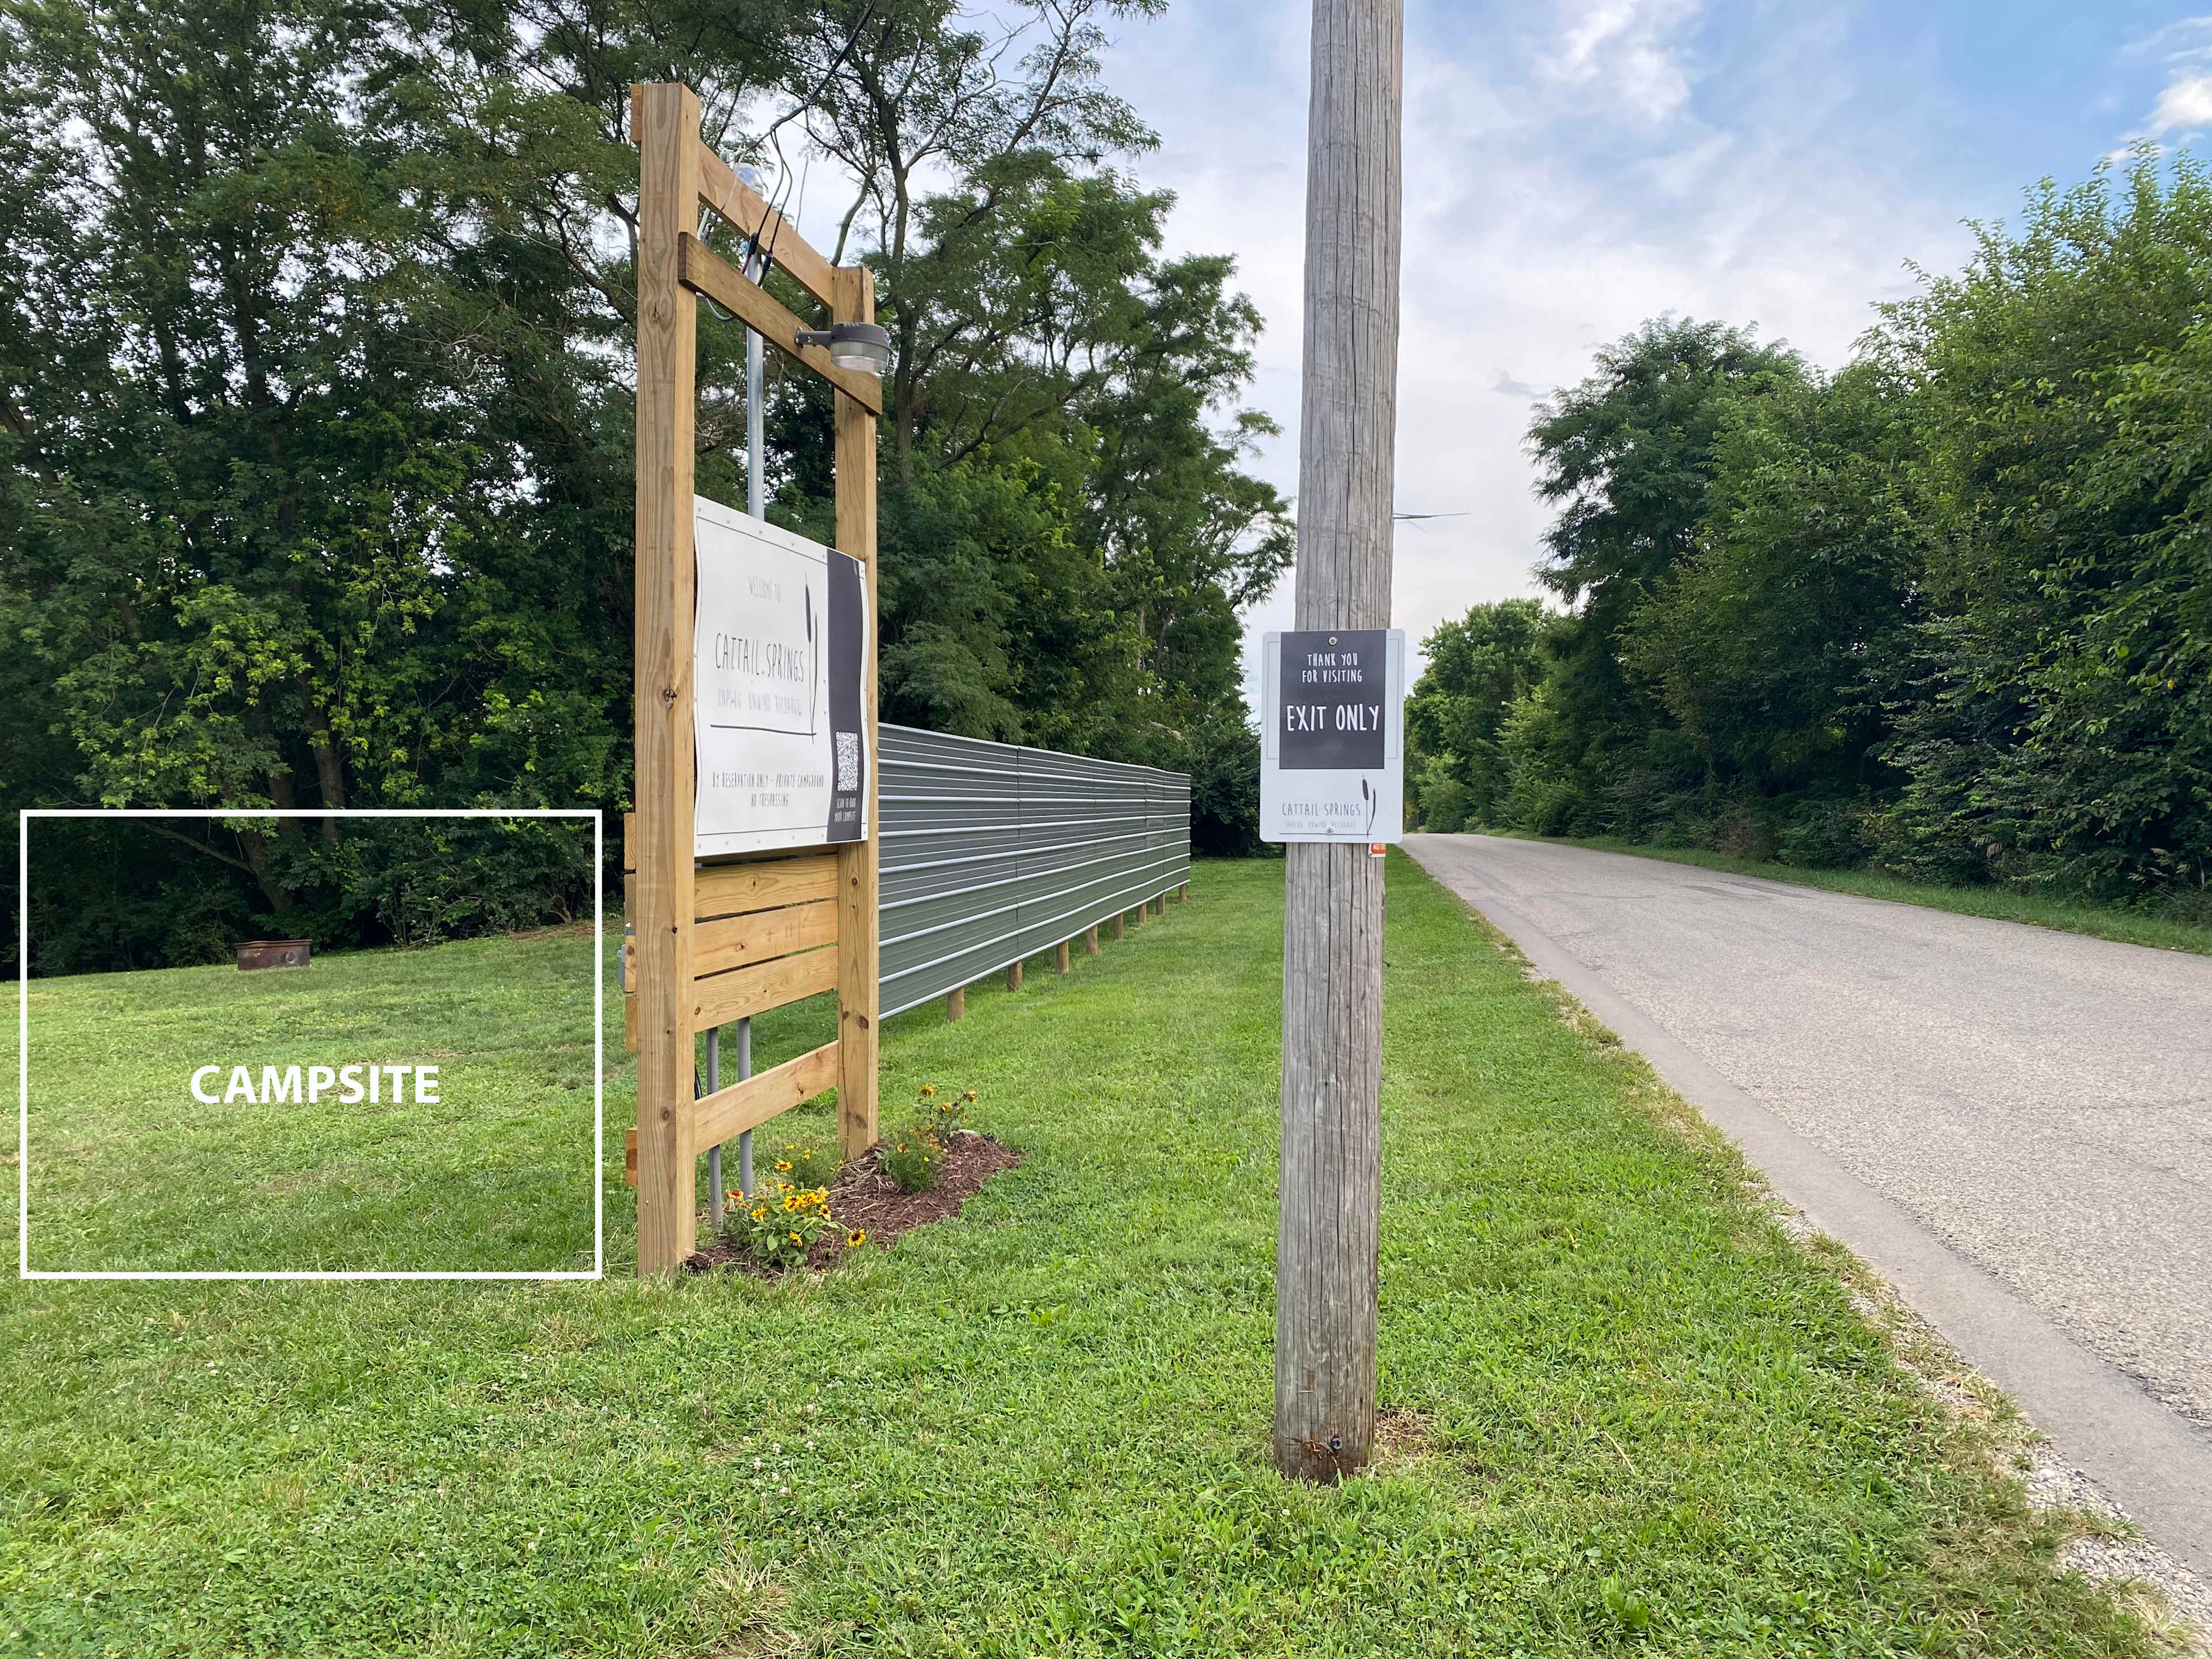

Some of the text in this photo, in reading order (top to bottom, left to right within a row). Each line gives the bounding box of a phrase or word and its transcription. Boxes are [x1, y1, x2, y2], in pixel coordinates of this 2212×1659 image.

[748, 576, 781, 603] WELCOME TO
[715, 632, 804, 682] CATTAIL SPRINGS
[1307, 652, 1358, 666] THANK YOU
[1302, 669, 1362, 683] FOR VISITING
[1286, 703, 1380, 731] EXIT ONLY
[713, 771, 719, 788] BY
[722, 771, 755, 788] RESERVATION
[756, 773, 768, 788] ONLY
[775, 773, 796, 788] PRIVATE
[797, 773, 824, 788] CAMPGROUND
[759, 793, 789, 807] TRESPASSING
[1282, 802, 1361, 816] CATTAIL SPRINGS
